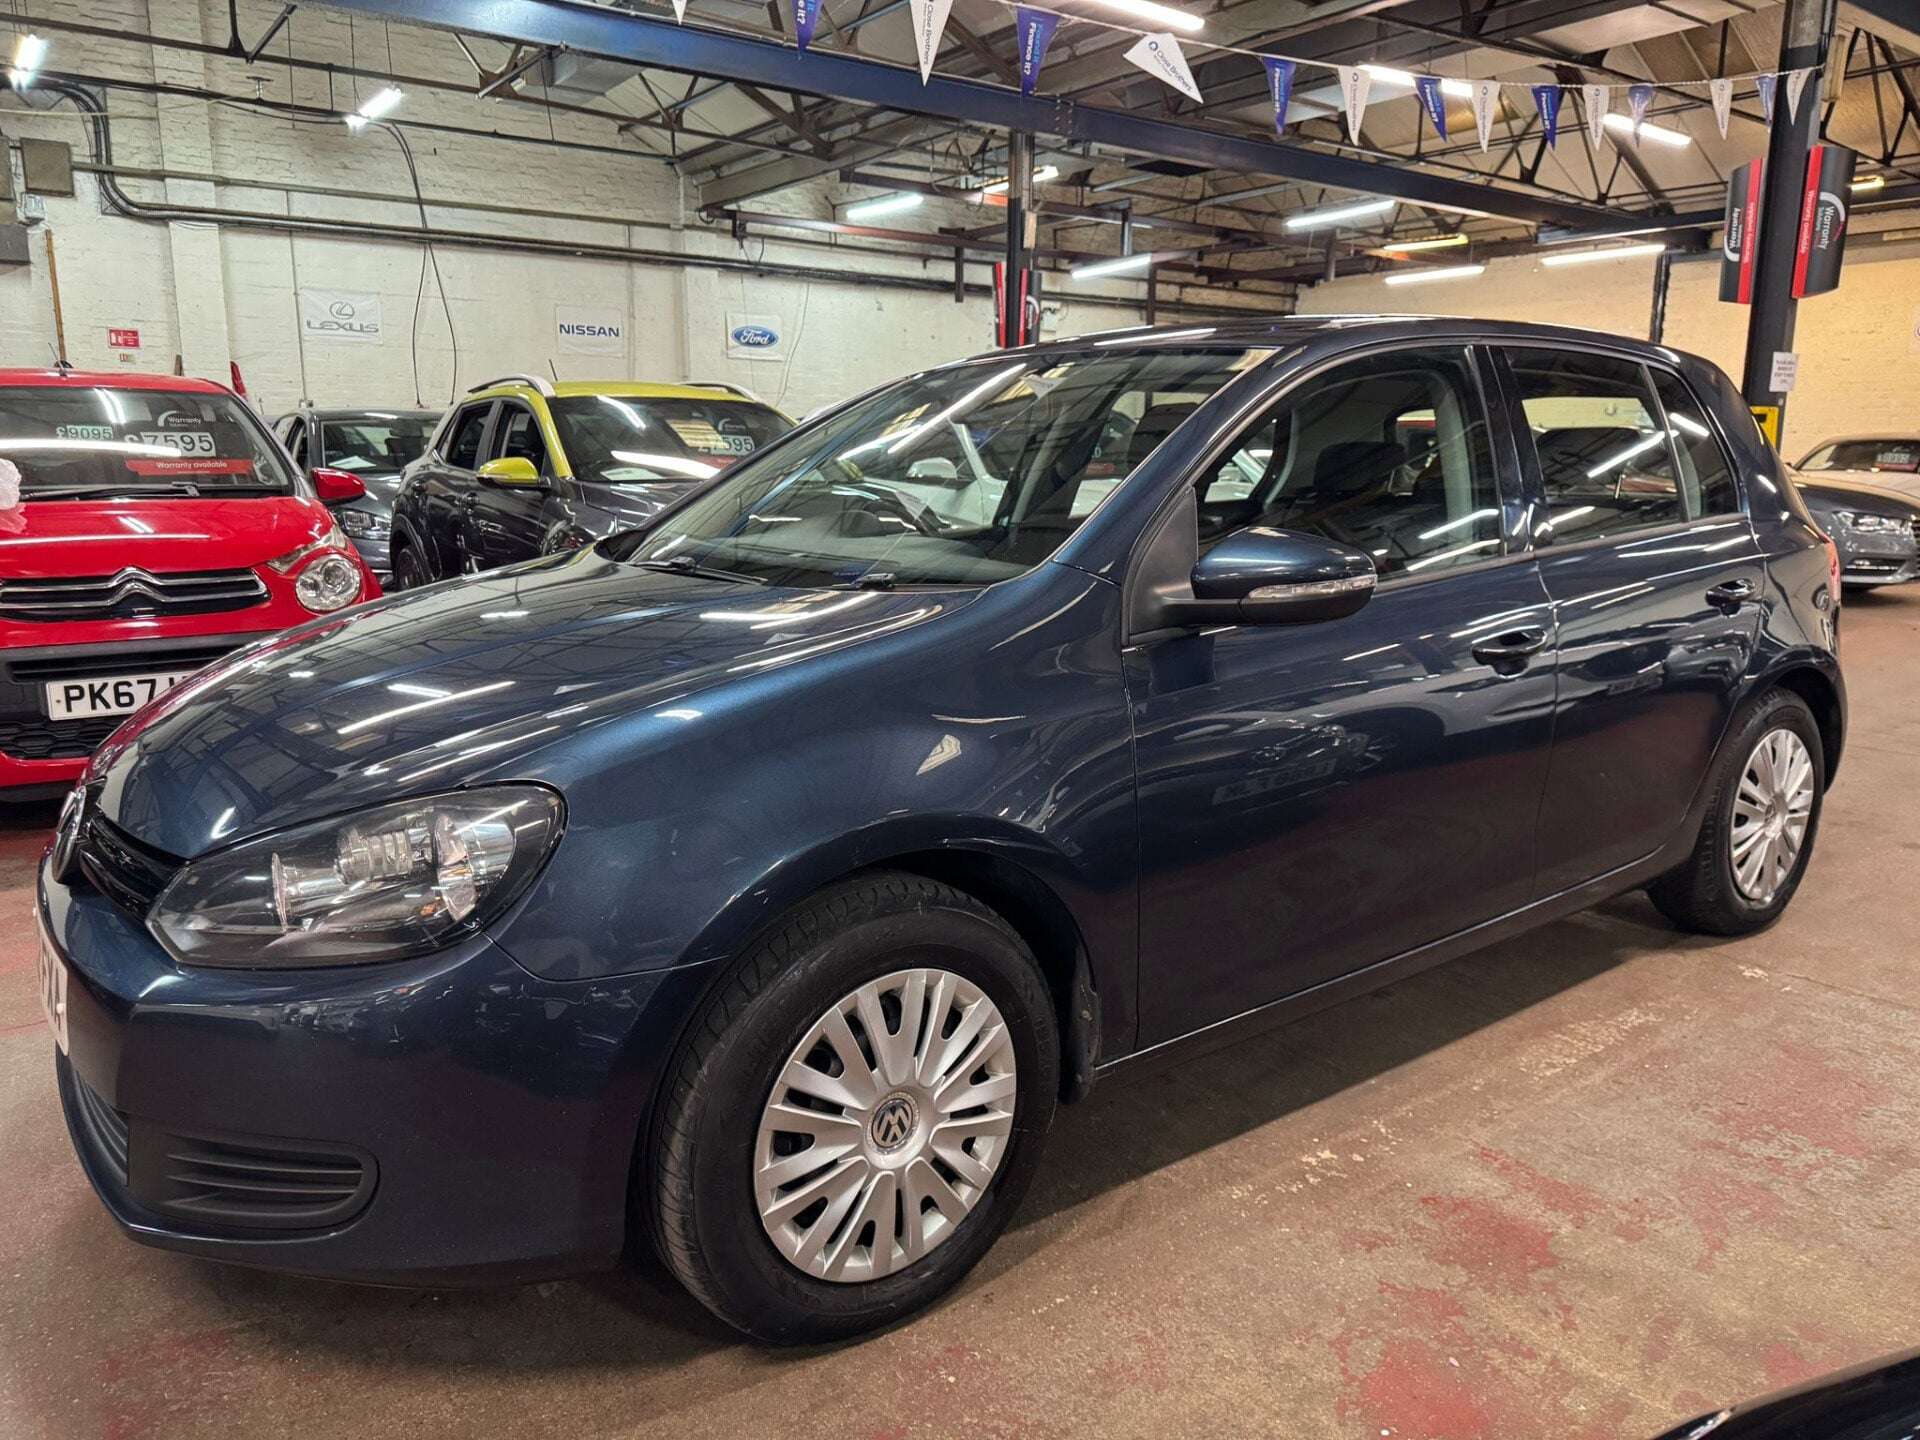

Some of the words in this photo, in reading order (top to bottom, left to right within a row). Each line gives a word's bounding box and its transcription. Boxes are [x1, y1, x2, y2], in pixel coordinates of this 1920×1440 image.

[924, 29, 932, 65] Brothers
[1026, 22, 1037, 60] Finance
[1157, 50, 1171, 67] Close
[1024, 61, 1032, 75] it?
[1804, 190, 1815, 221] Warranty
[1729, 208, 1741, 248] Warranty
[1818, 206, 1834, 249] Warranty
[306, 320, 379, 333] LEXUS
[559, 323, 620, 337] NISSAN
[741, 328, 770, 345] Ford
[167, 416, 201, 425] Warranty
[56, 426, 113, 440] £9095
[124, 433, 213, 453] £7595
[698, 435, 753, 453] 595
[156, 461, 192, 470] Warranty
[193, 461, 228, 469] available
[63, 678, 157, 713] PK67
